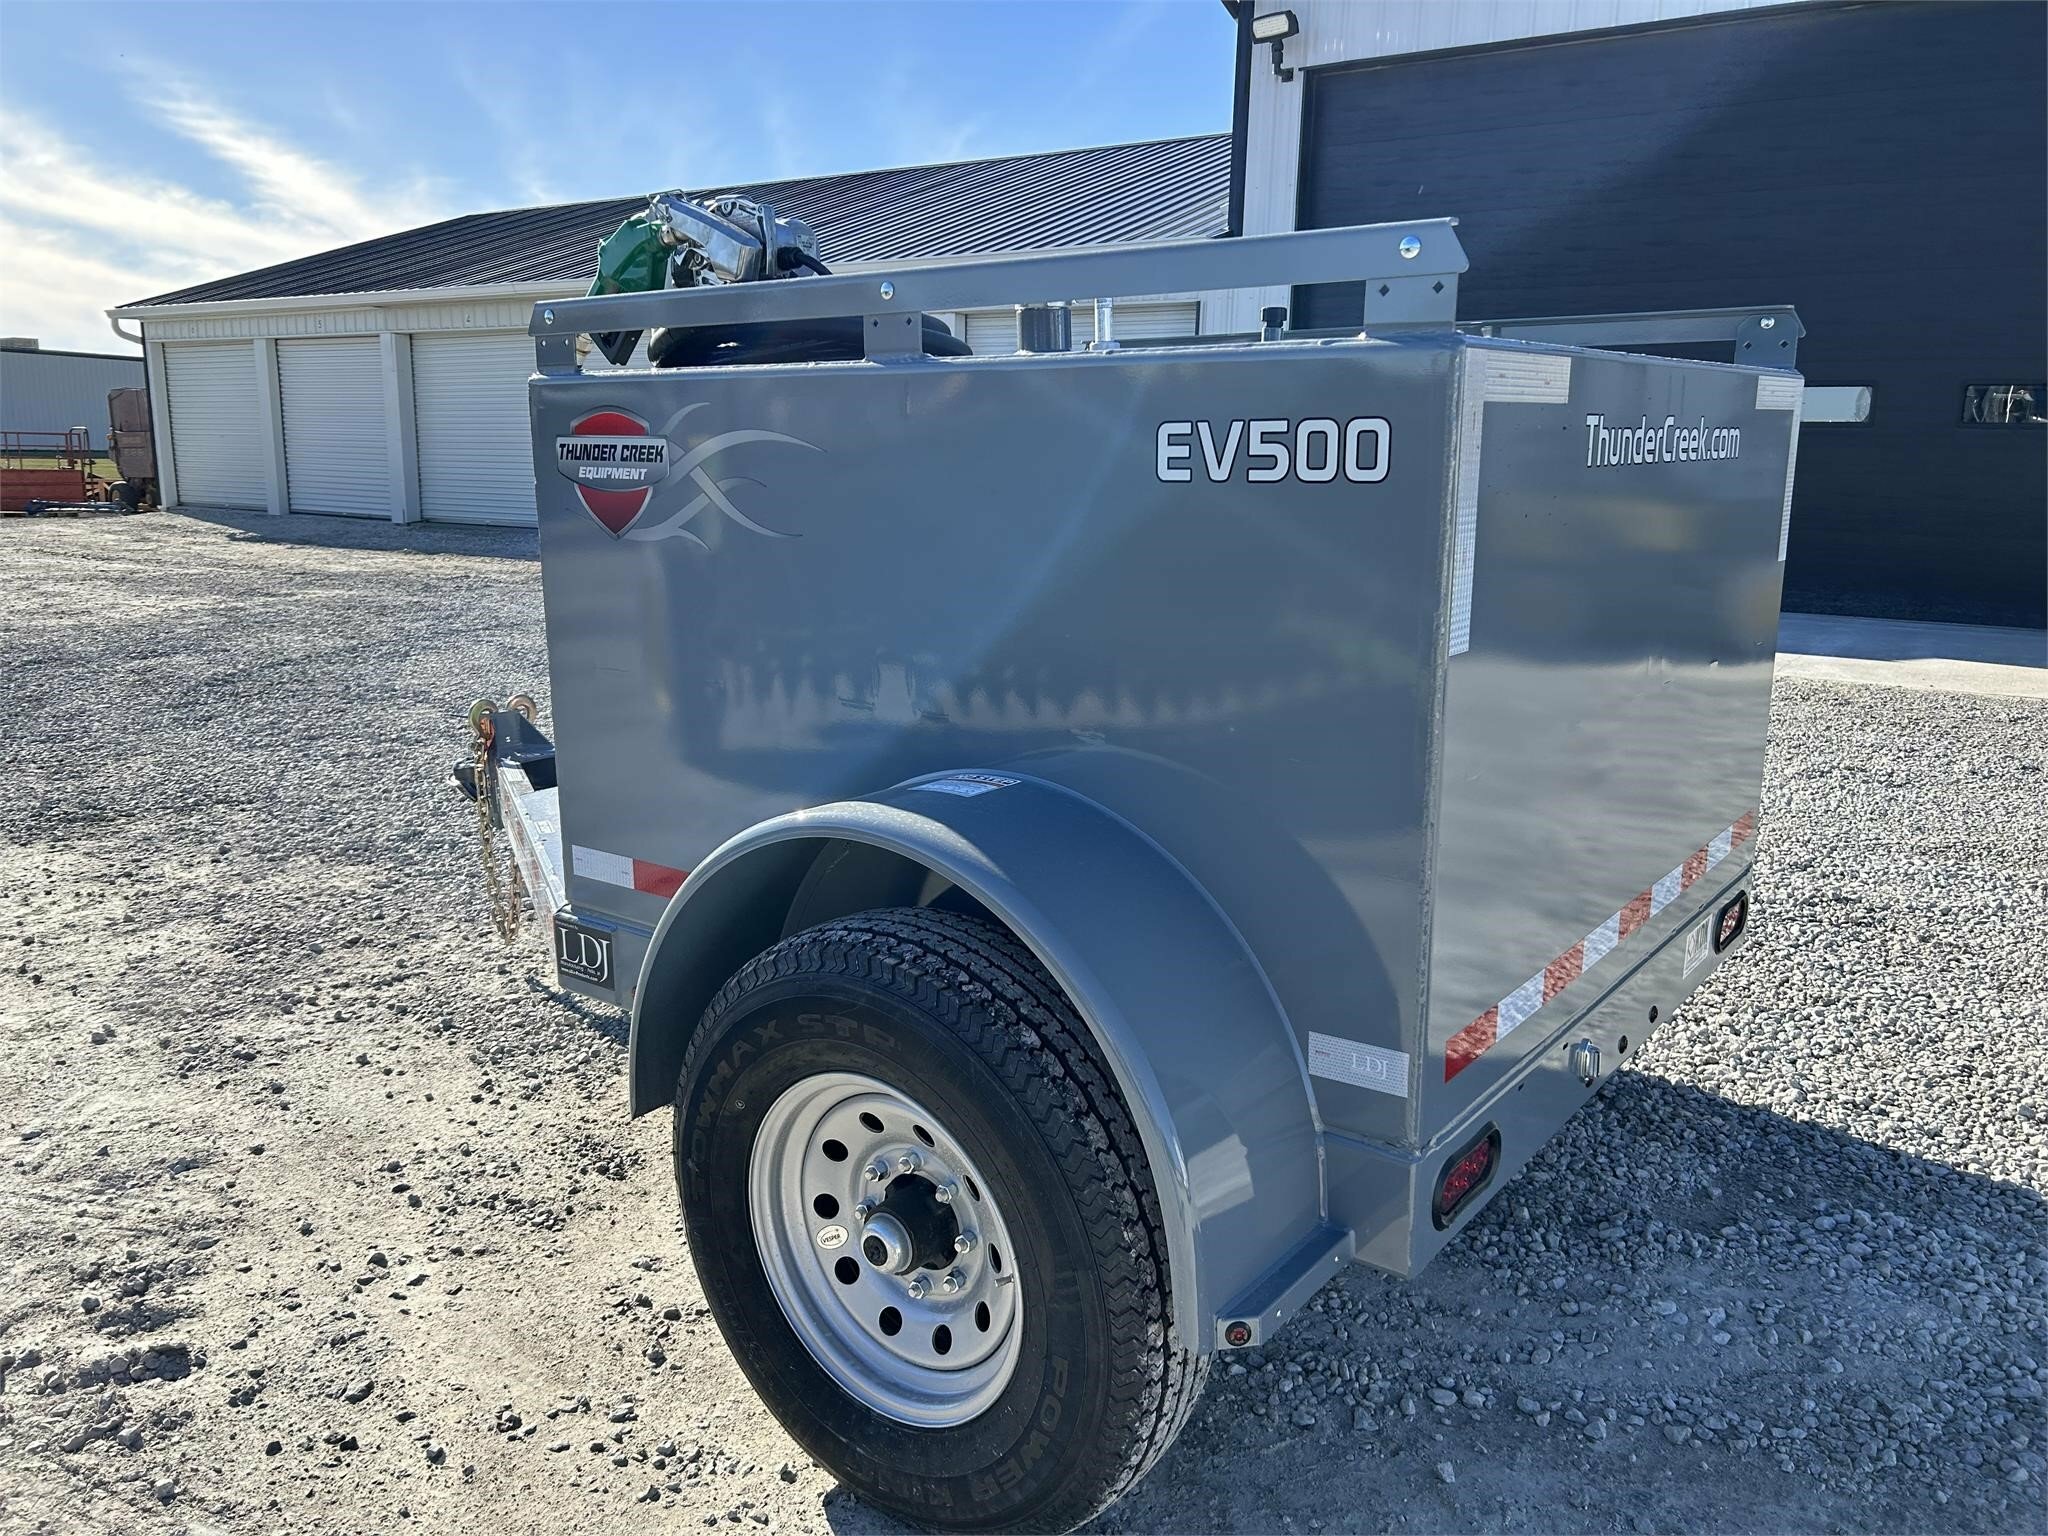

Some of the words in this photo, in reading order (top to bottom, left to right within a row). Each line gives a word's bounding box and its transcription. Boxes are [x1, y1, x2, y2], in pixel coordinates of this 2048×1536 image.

[558, 443, 617, 462] THUNDER
[620, 444, 664, 463] CREEK
[1156, 416, 1392, 484] EV500
[1586, 414, 1741, 468] ThunderCreek.com
[578, 466, 648, 481] EQUIPMENT
[558, 927, 611, 983] LDJ
[1352, 1052, 1388, 1080] LDJ
[970, 1355, 1070, 1503] POWER
